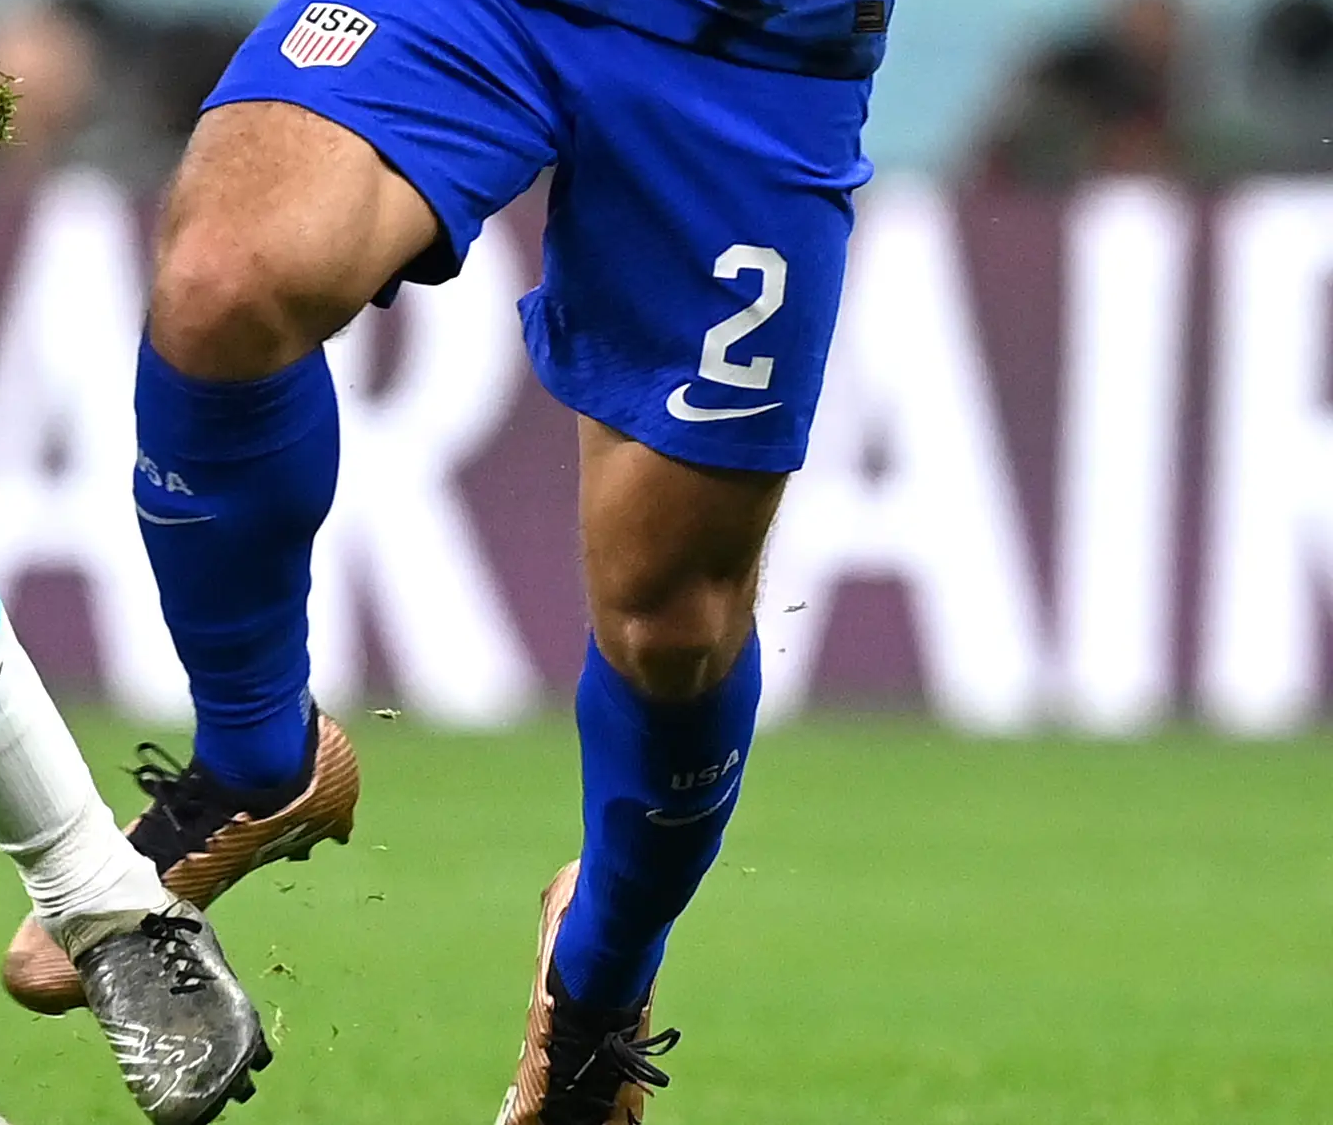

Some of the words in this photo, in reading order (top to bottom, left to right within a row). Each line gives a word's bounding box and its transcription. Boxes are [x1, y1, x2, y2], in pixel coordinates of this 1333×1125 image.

[305, 7, 369, 36] USA
[699, 244, 787, 390] 2
[671, 748, 740, 791] USA
